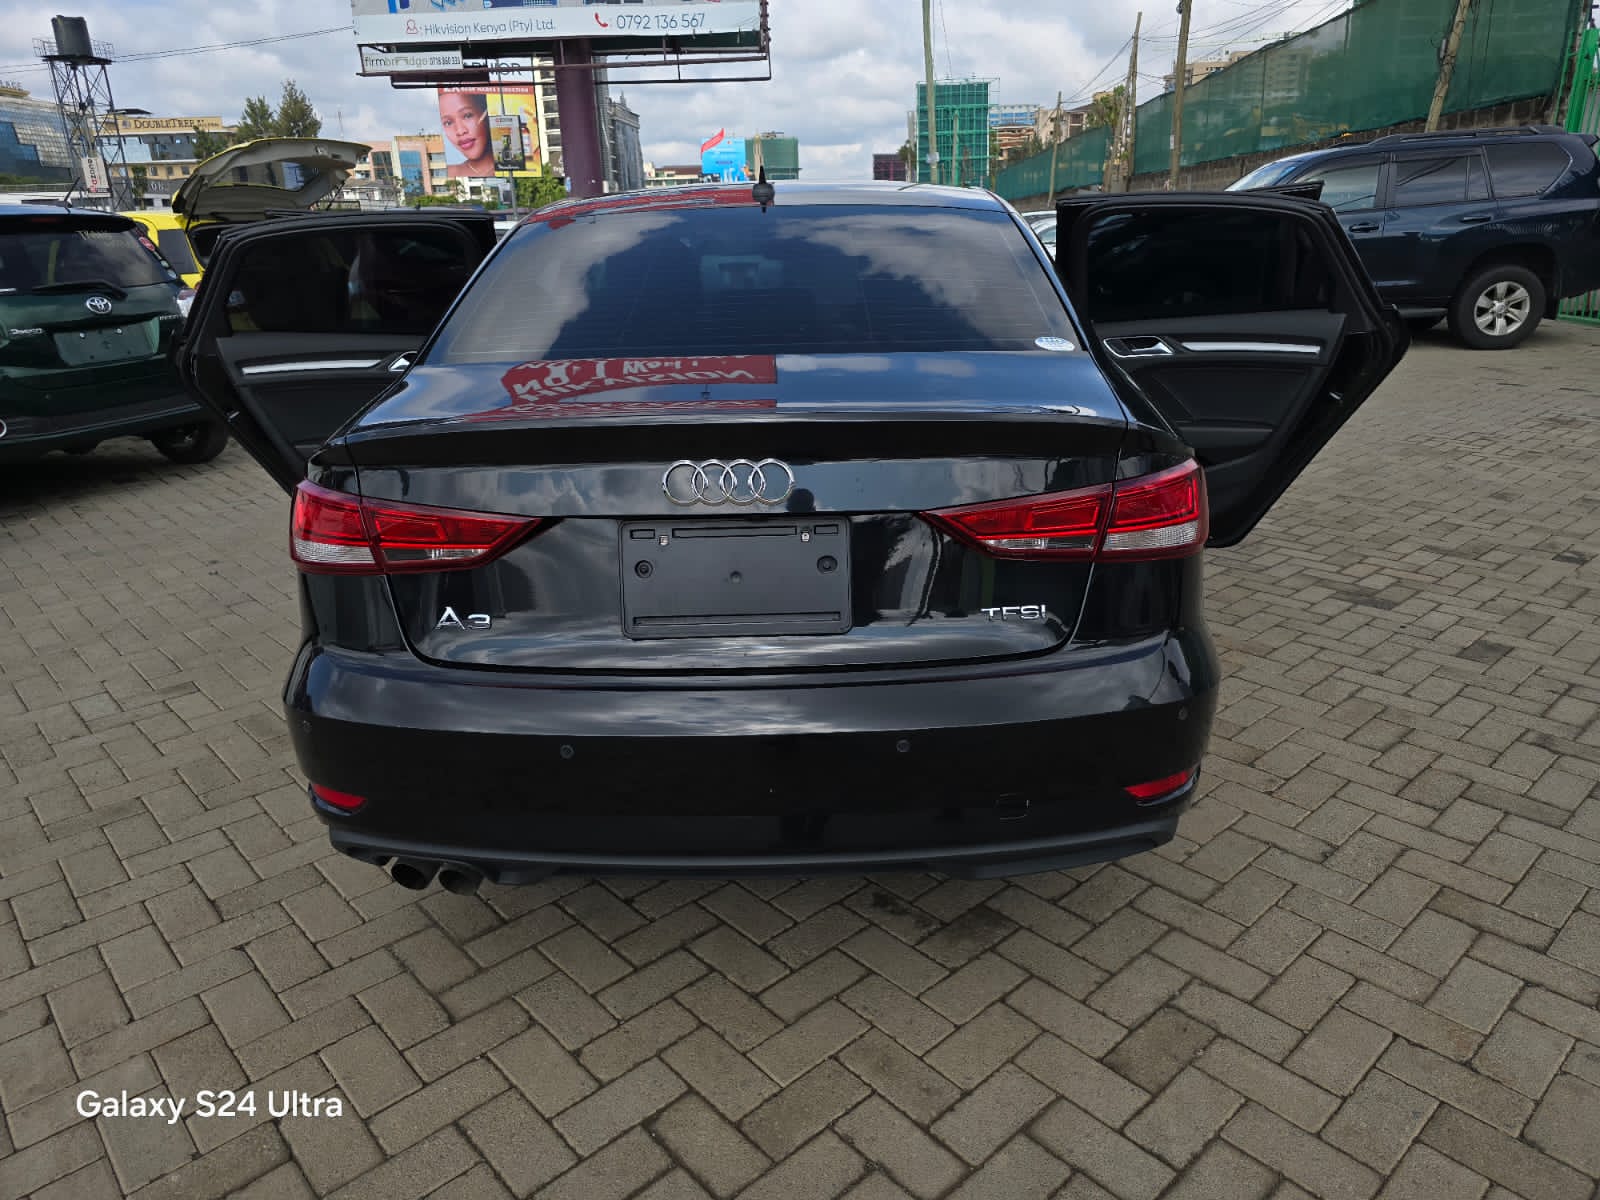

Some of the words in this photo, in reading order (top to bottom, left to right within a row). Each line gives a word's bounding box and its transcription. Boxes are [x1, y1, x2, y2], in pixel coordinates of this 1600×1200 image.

[424, 23, 471, 35] Hikvision
[473, 22, 506, 35] Kenya
[509, 17, 532, 33] (Pty)
[536, 18, 555, 31] Ltd.
[616, 15, 650, 30] 0792
[655, 14, 678, 29] 136
[681, 13, 705, 28] 567
[435, 606, 491, 630] A3
[980, 604, 1047, 620] TFSI
